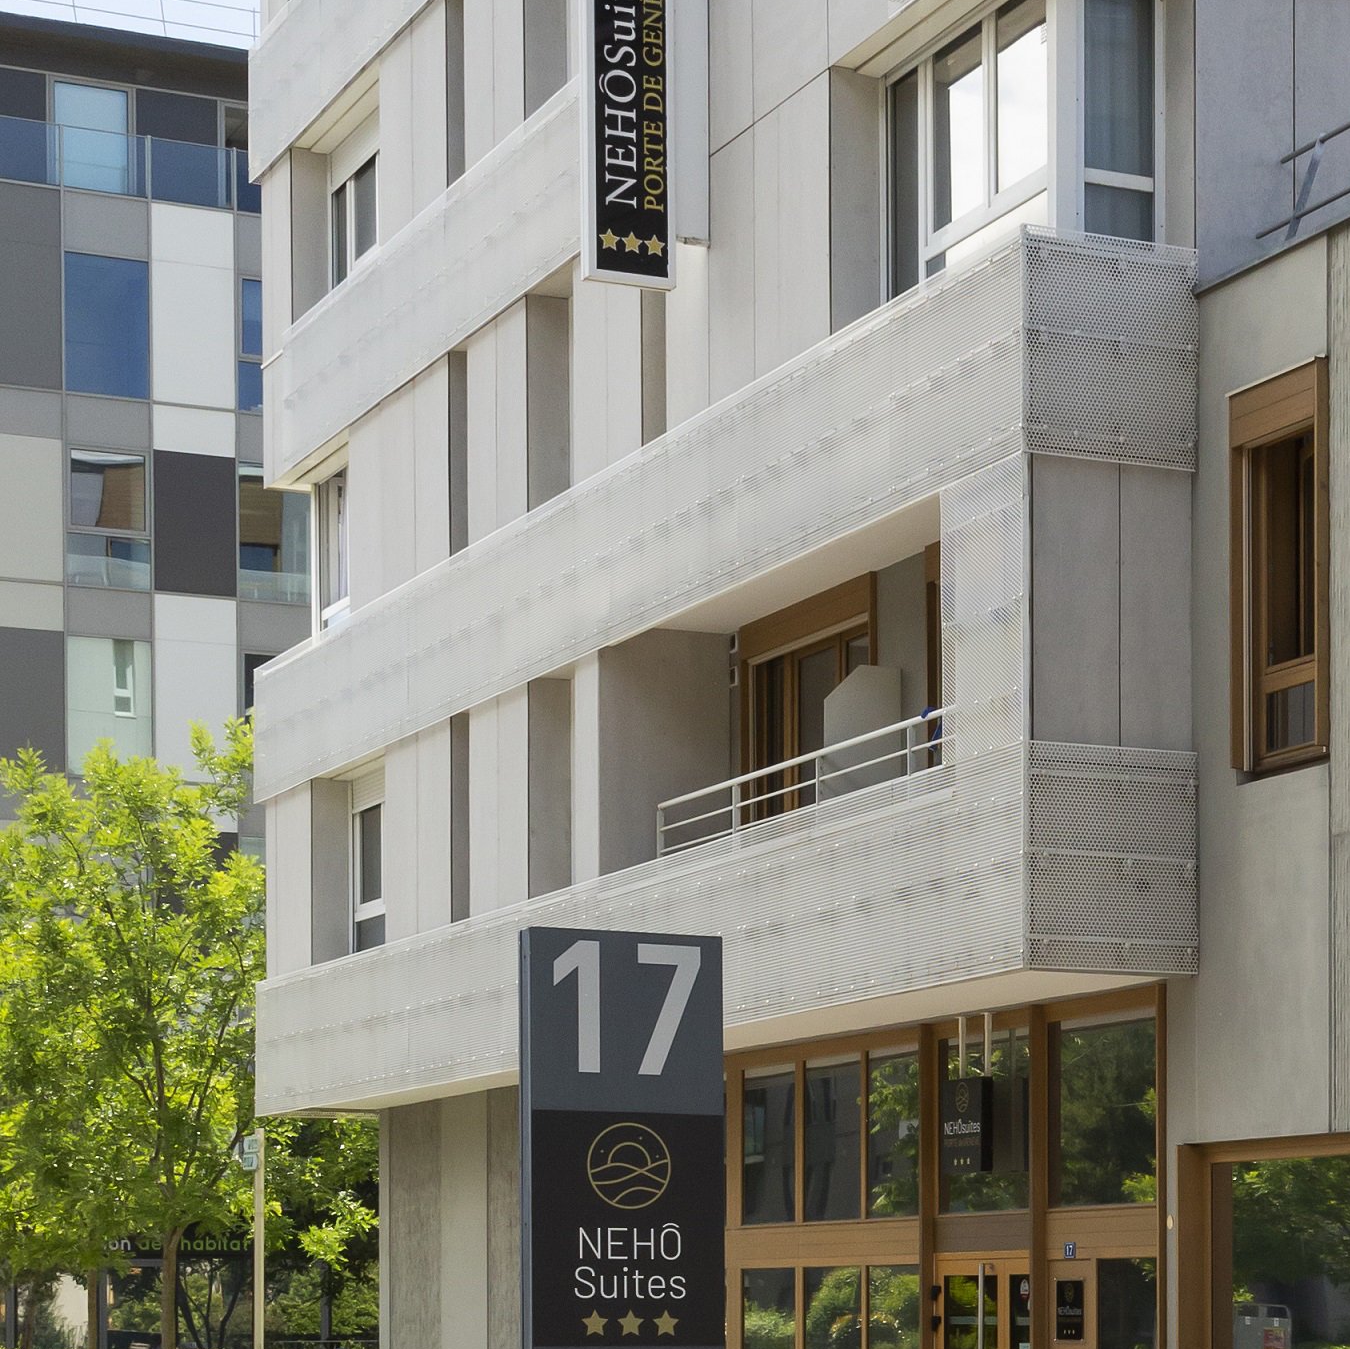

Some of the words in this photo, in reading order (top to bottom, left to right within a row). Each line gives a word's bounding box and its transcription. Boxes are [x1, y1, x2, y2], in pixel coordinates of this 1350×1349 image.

[642, 75, 664, 113] DE
[643, 120, 665, 213] PORTE
[553, 939, 701, 1076] 17
[579, 1222, 681, 1261] NEHÔ
[574, 1266, 687, 1299] Suites
